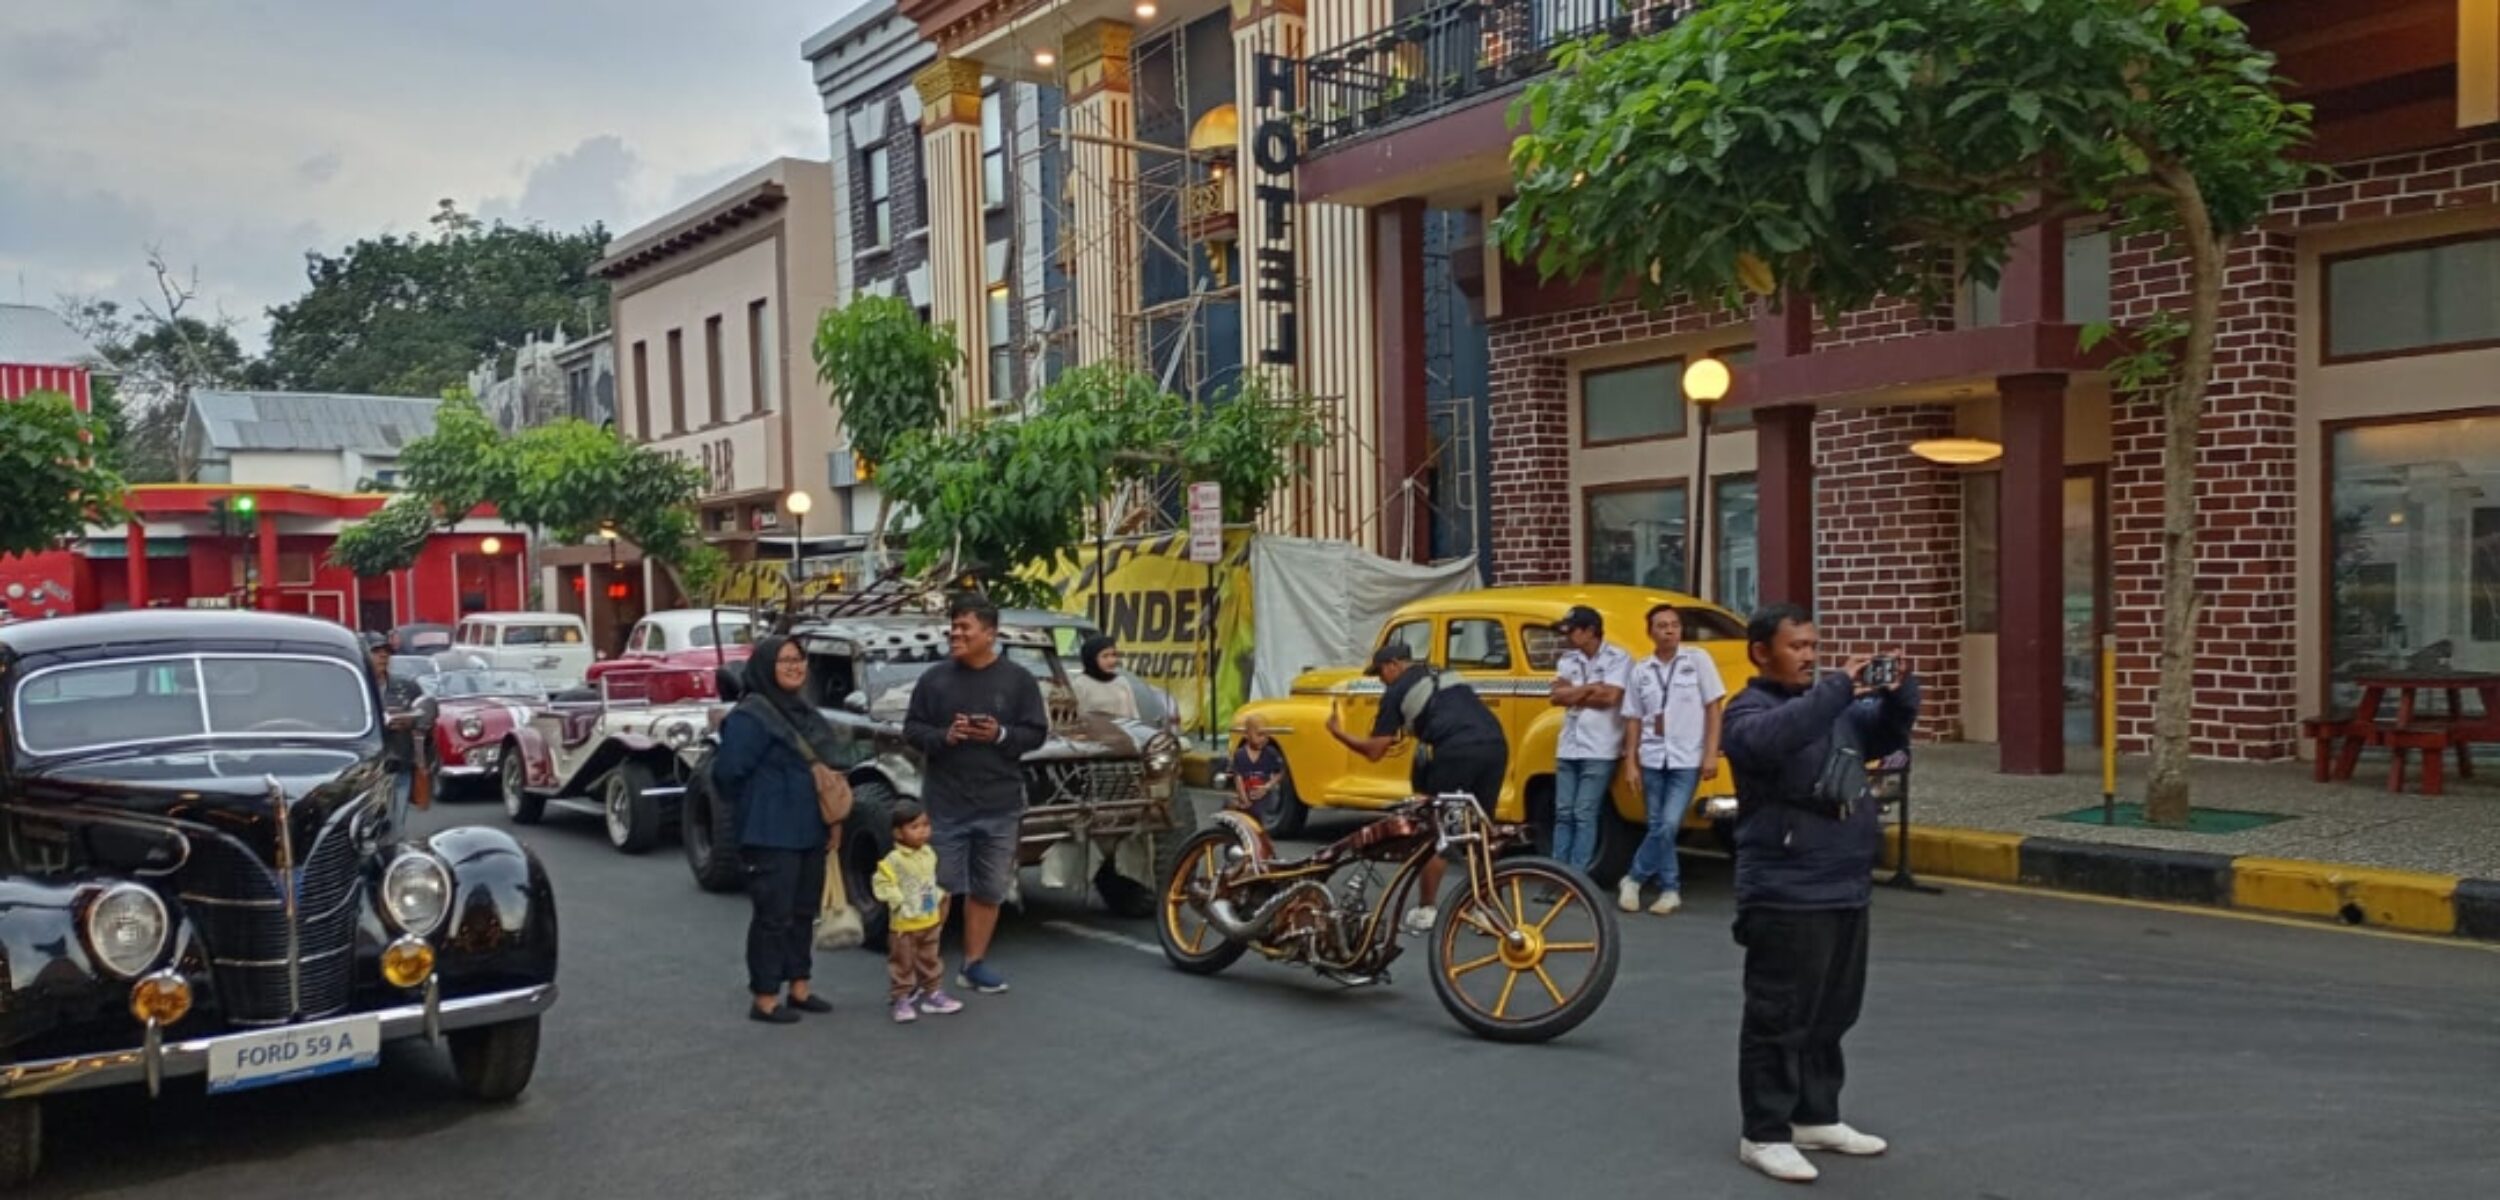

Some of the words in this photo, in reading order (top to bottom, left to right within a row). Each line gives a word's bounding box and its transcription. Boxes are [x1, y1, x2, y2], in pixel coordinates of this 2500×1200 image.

[1087, 588, 1220, 642] UNDER
[237, 1042, 299, 1068] FORD
[306, 1036, 332, 1057] 59
[337, 1032, 354, 1052] A
